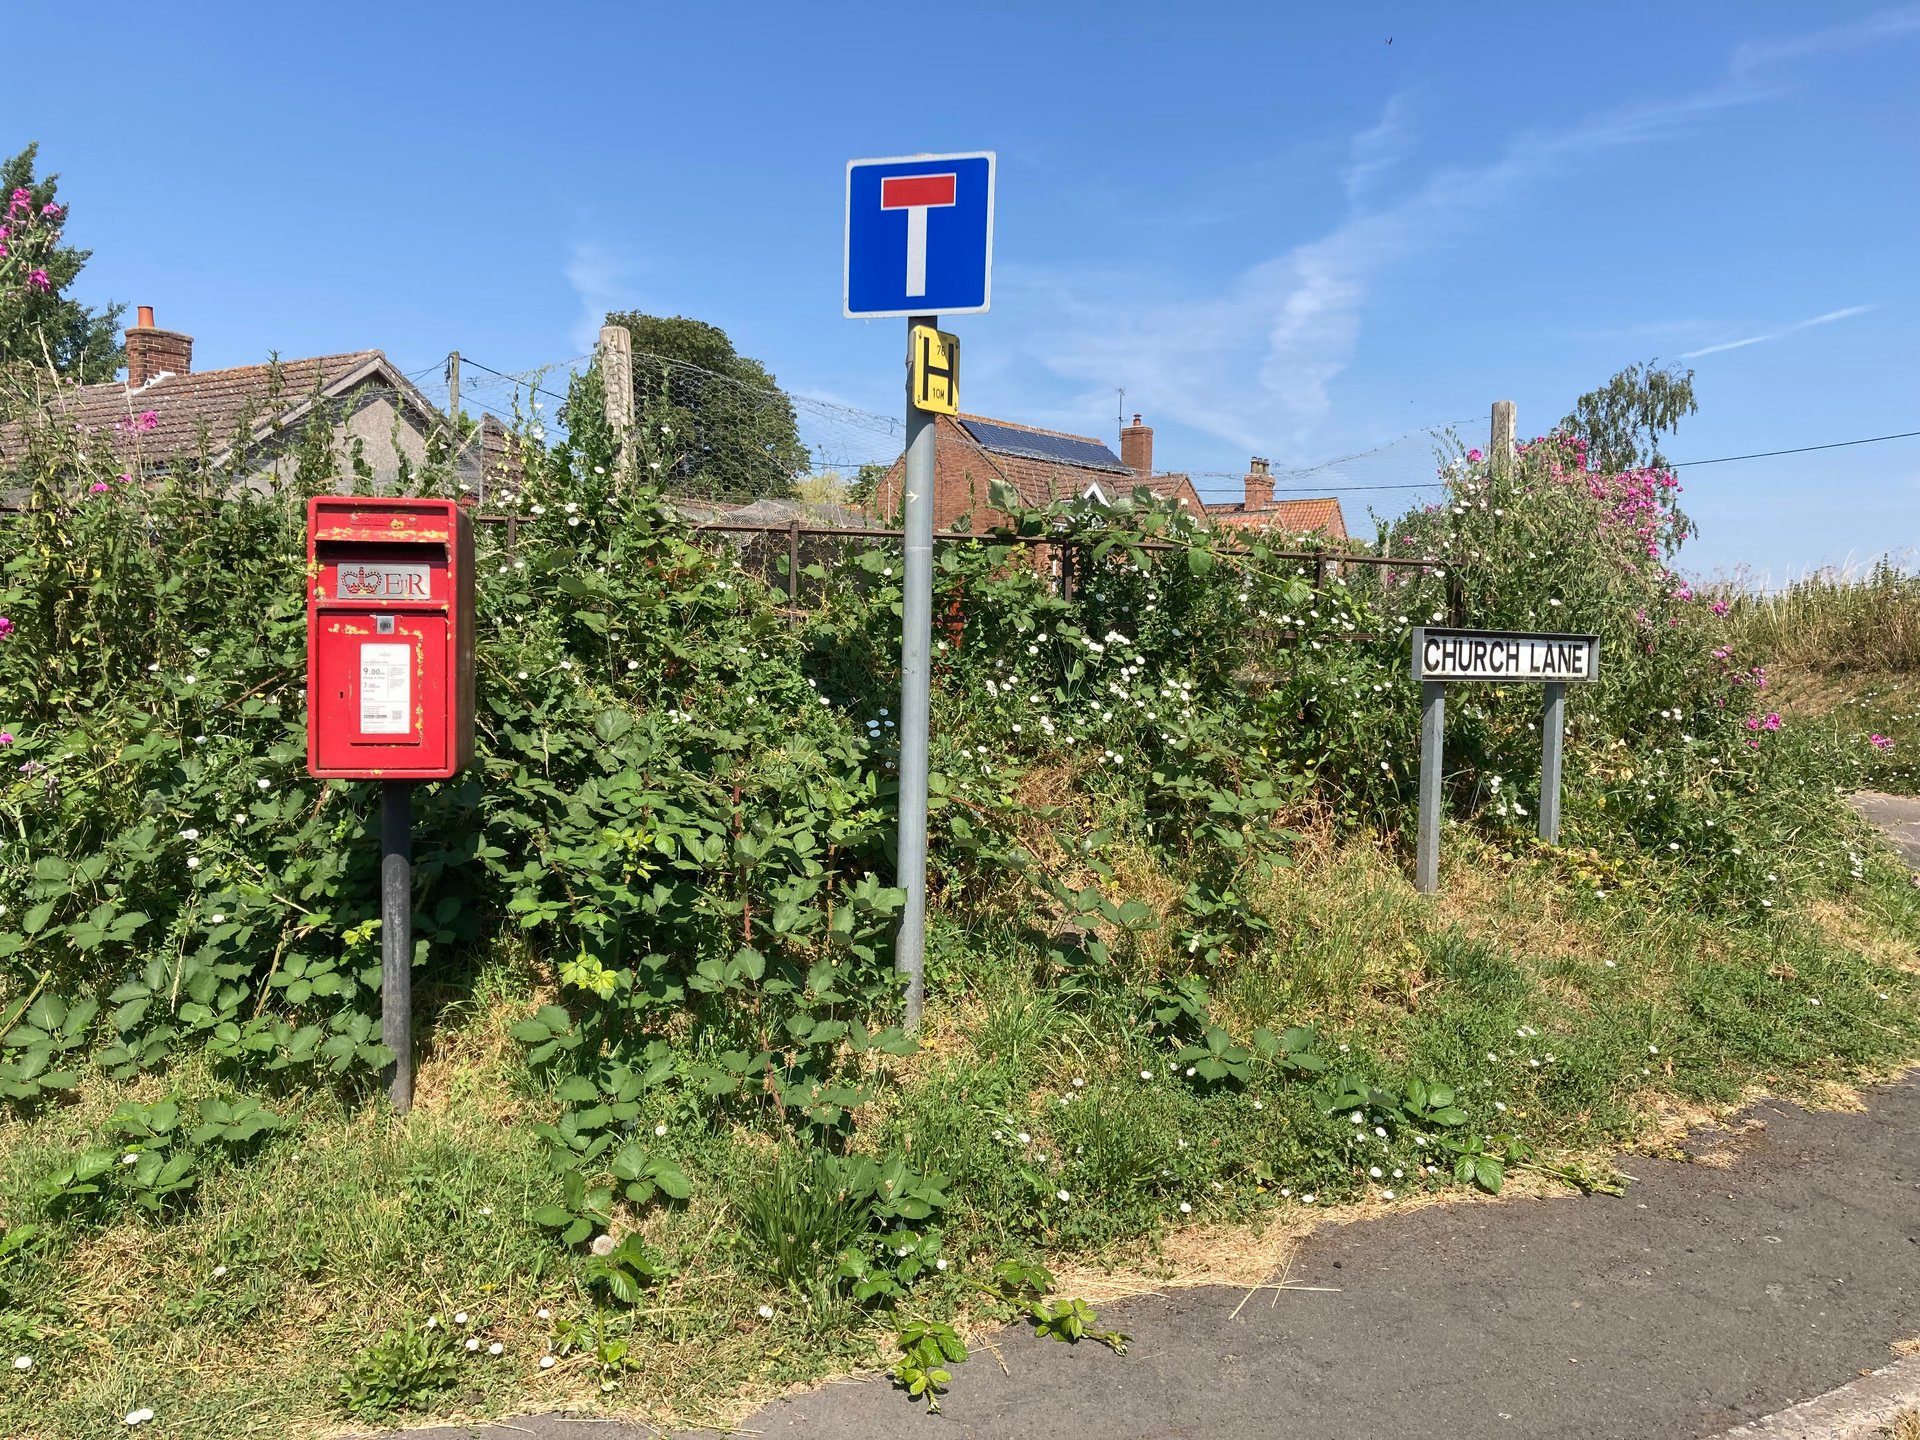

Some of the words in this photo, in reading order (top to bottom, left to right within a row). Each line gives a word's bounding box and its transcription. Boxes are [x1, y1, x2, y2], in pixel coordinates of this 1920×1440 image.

[923, 337, 954, 406] H
[932, 387, 944, 400] 10M
[1423, 638, 1520, 673] CHURCH
[1529, 643, 1583, 674] LANE
